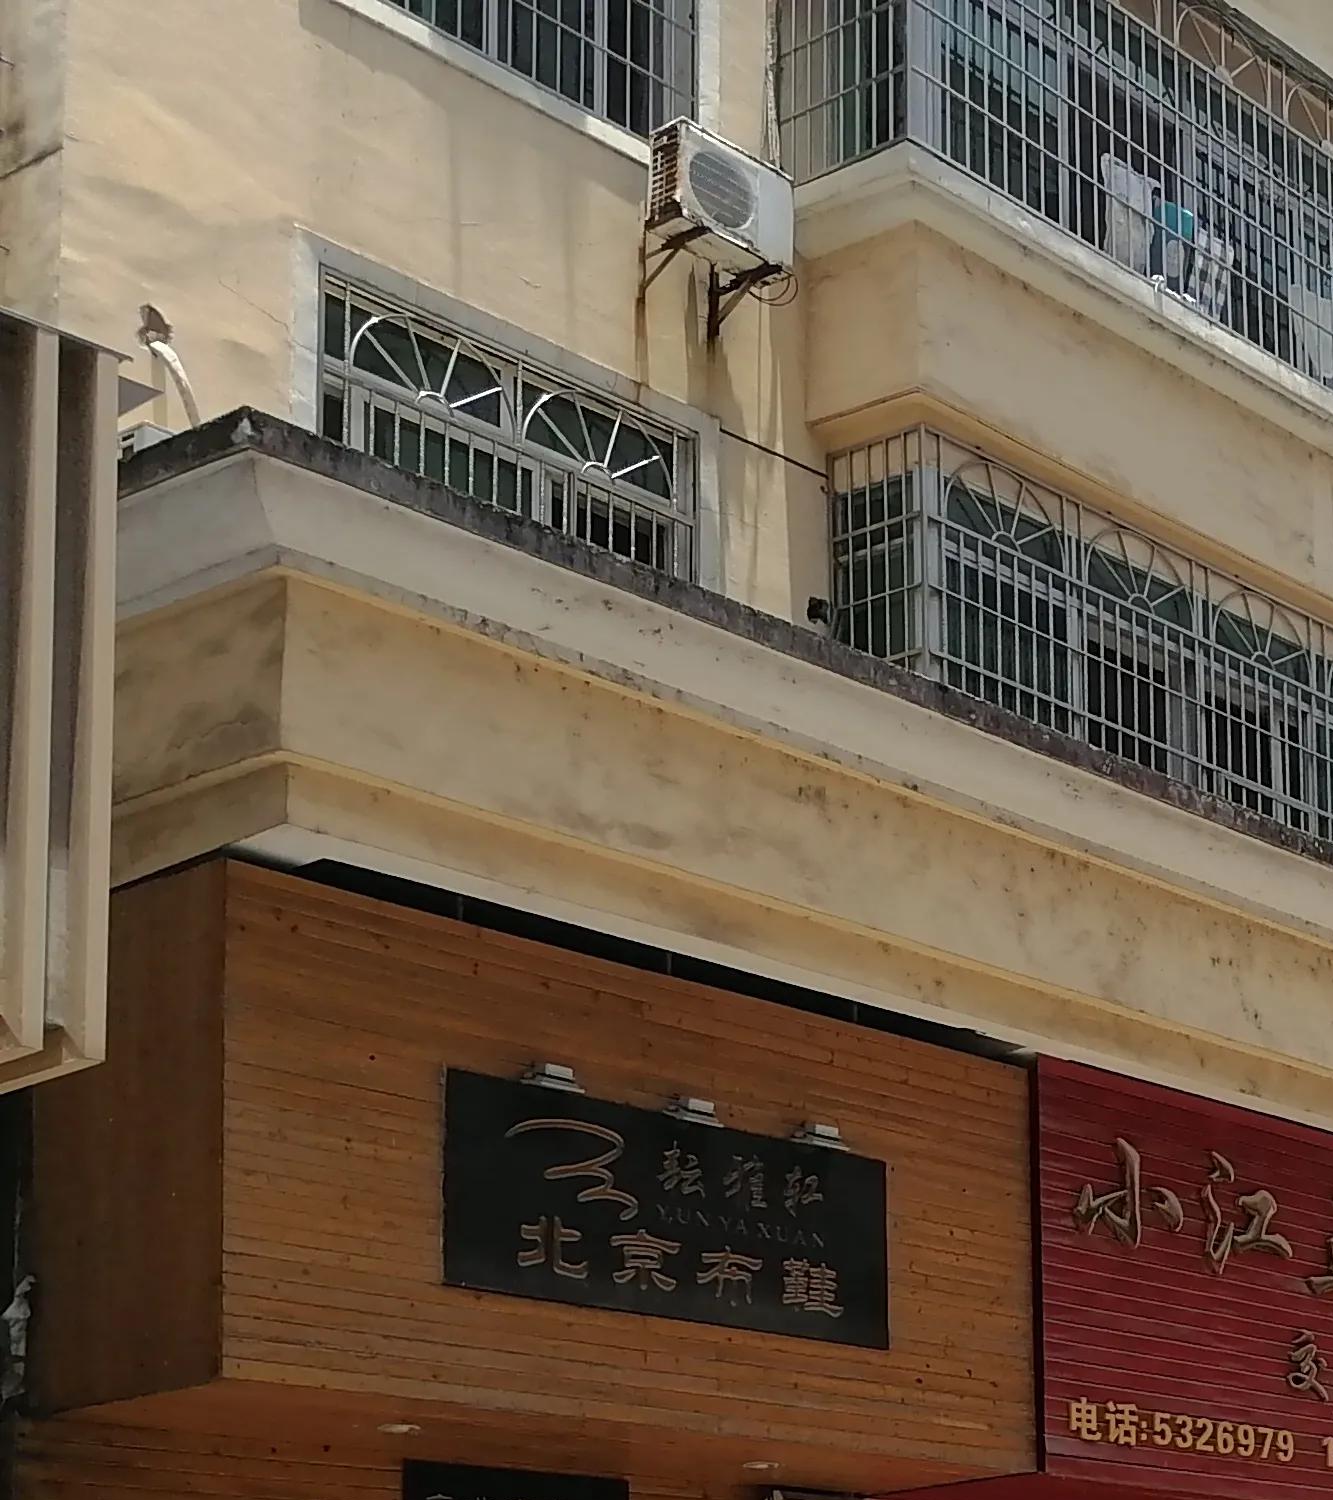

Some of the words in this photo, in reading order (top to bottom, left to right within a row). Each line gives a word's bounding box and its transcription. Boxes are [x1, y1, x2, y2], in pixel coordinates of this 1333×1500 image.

[719, 1215, 748, 1235] YA
[757, 1222, 824, 1248] XUAN
[517, 1215, 844, 1318] 北京布鞋
